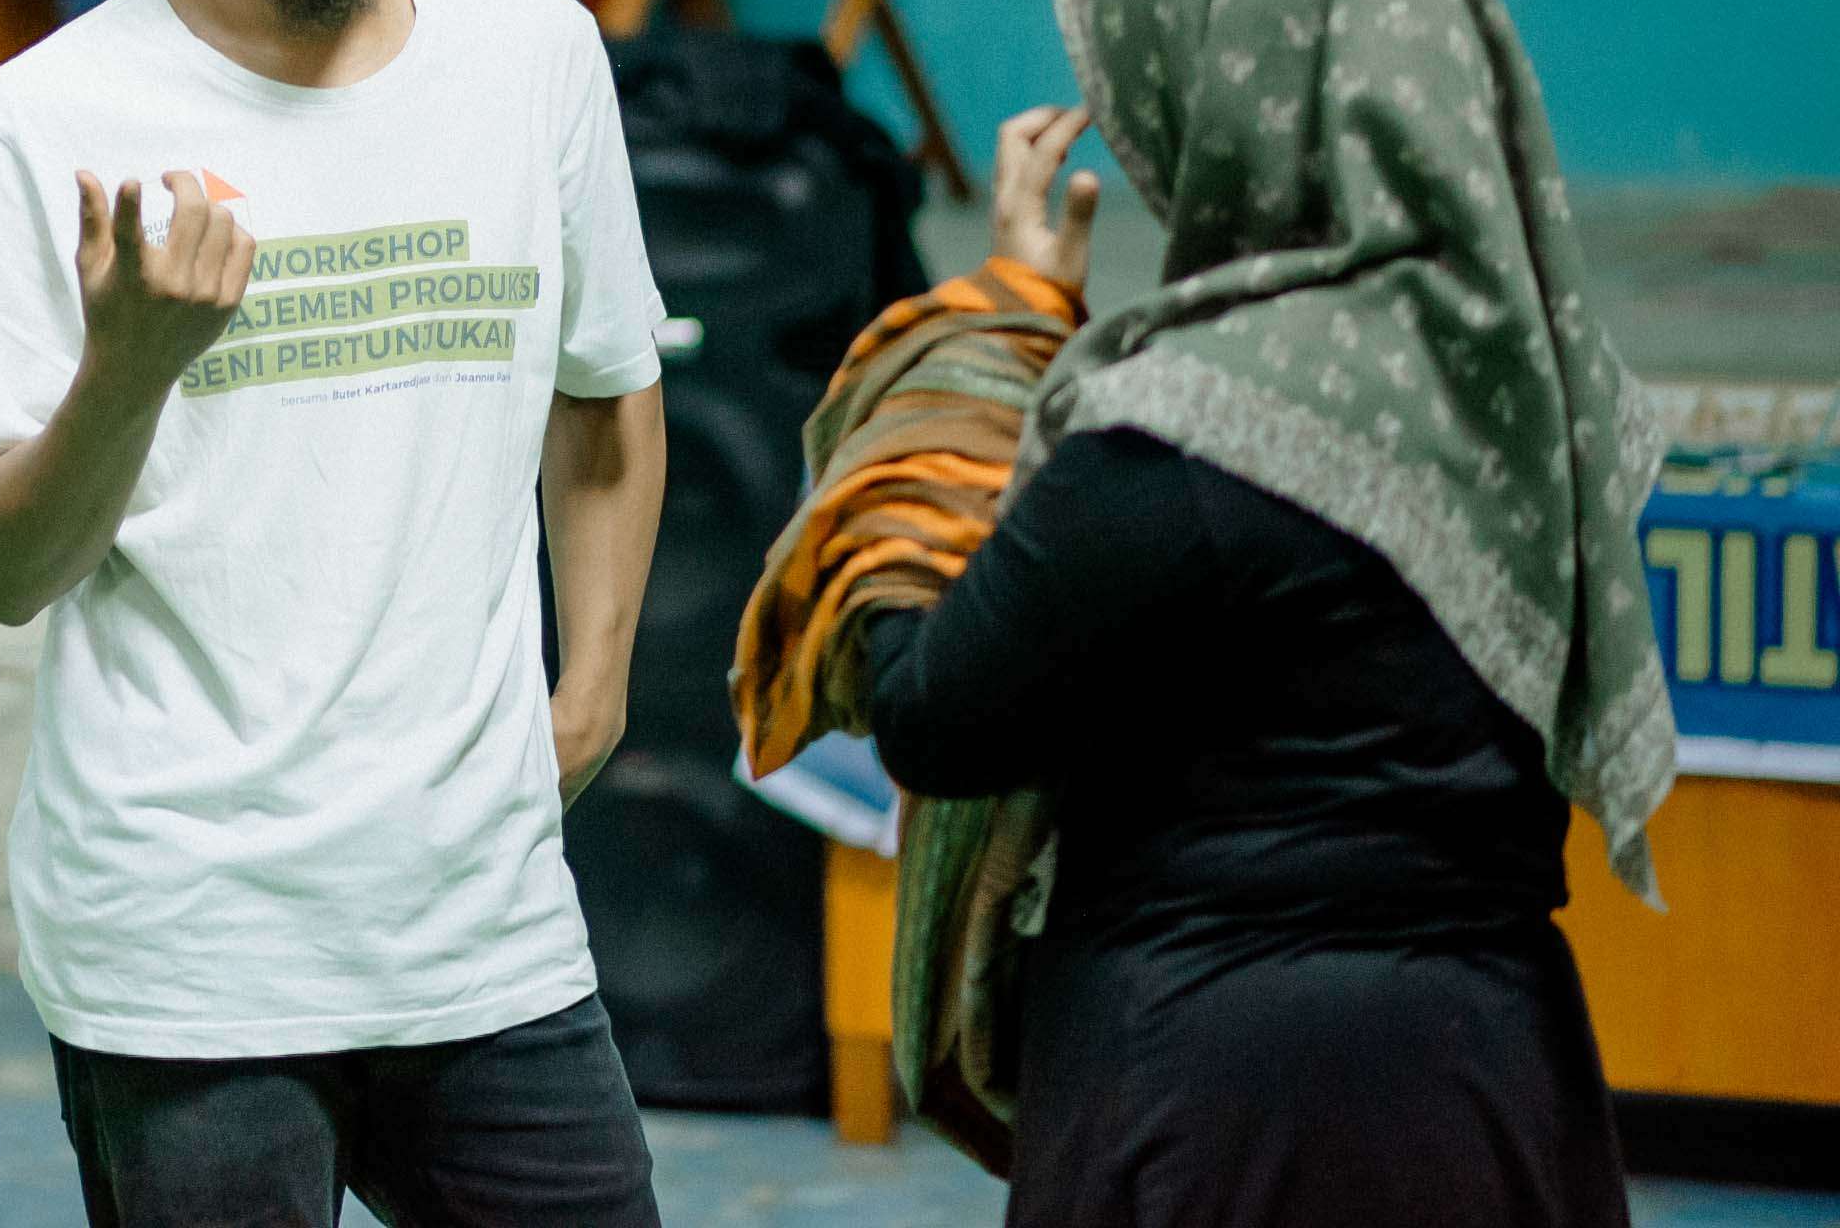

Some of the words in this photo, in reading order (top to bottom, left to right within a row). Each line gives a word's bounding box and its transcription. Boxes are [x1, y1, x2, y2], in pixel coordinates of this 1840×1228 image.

[251, 228, 464, 281] WORKSHOP
[228, 285, 373, 335] AJEMEN
[390, 272, 540, 310] PRODUKSI
[182, 348, 264, 389] SENI
[277, 319, 516, 373] PERTUNJUKAN
